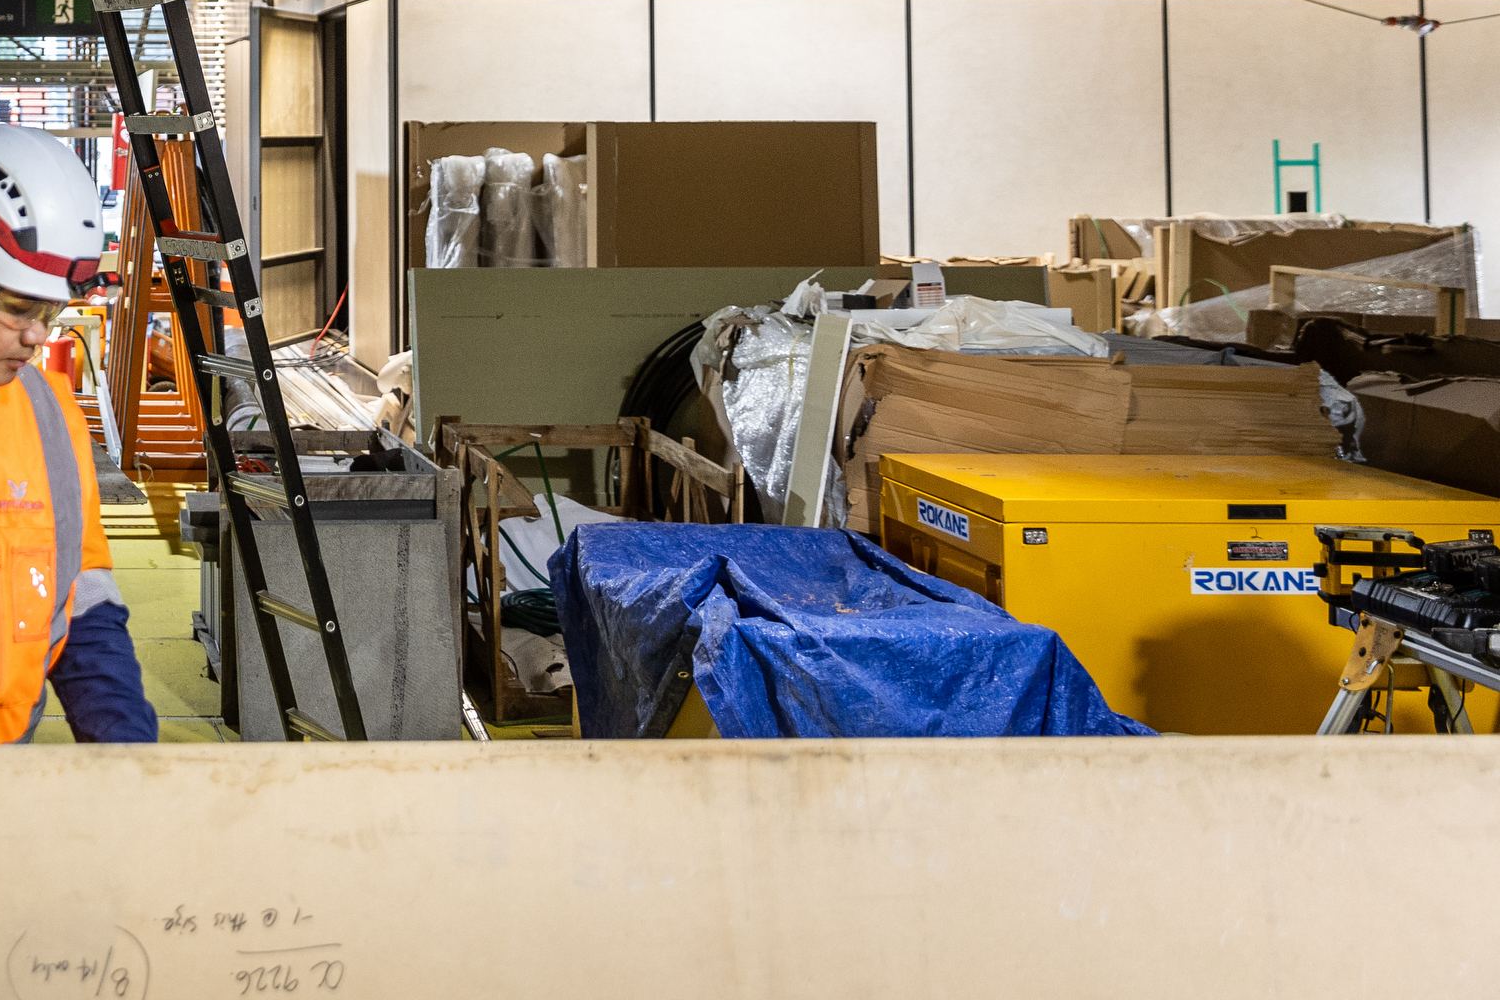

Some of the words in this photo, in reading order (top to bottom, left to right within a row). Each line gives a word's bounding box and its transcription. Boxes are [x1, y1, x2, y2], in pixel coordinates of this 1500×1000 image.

[918, 501, 968, 538] ROKANE
[1194, 571, 1320, 591] ROKANE
[215, 912, 247, 931] this
